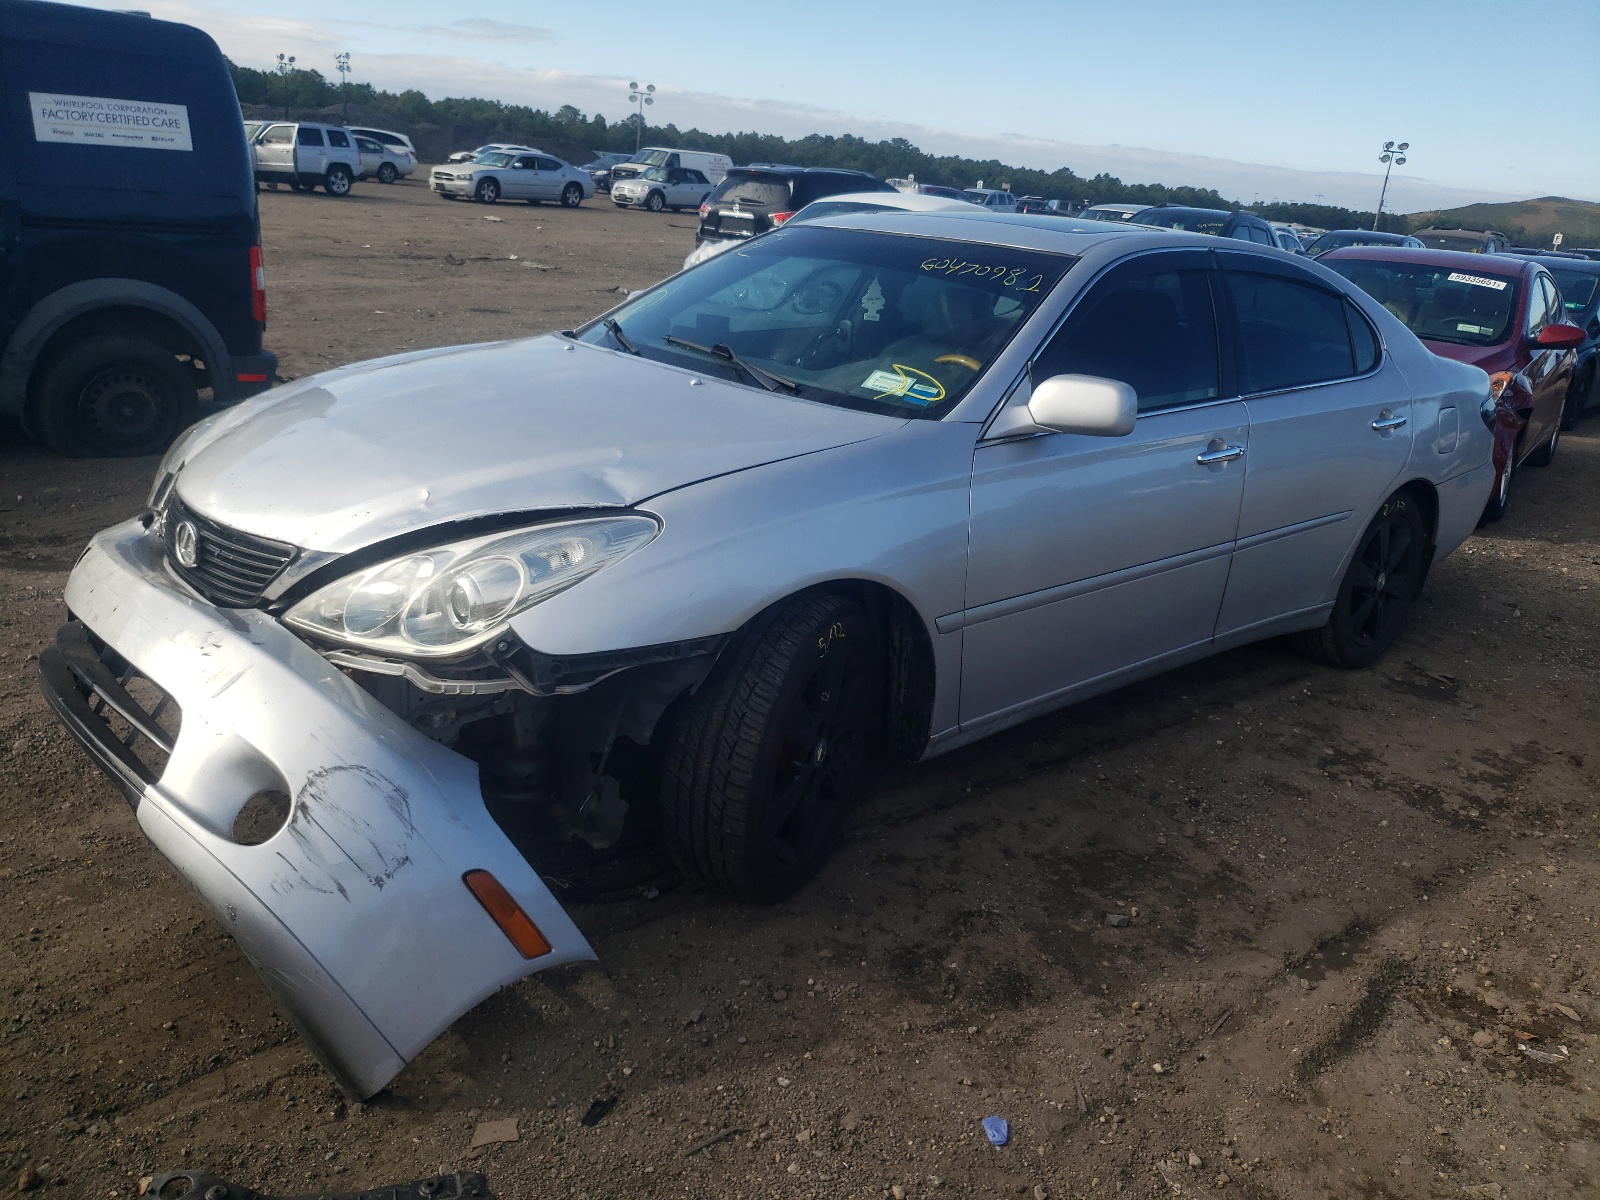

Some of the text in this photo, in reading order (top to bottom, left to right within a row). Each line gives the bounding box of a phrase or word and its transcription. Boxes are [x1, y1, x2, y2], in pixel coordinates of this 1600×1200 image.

[54, 99, 168, 116] WHIRLPOOL CORPORATION
[42, 108, 181, 129] FACTORY CERTIFIED CARE
